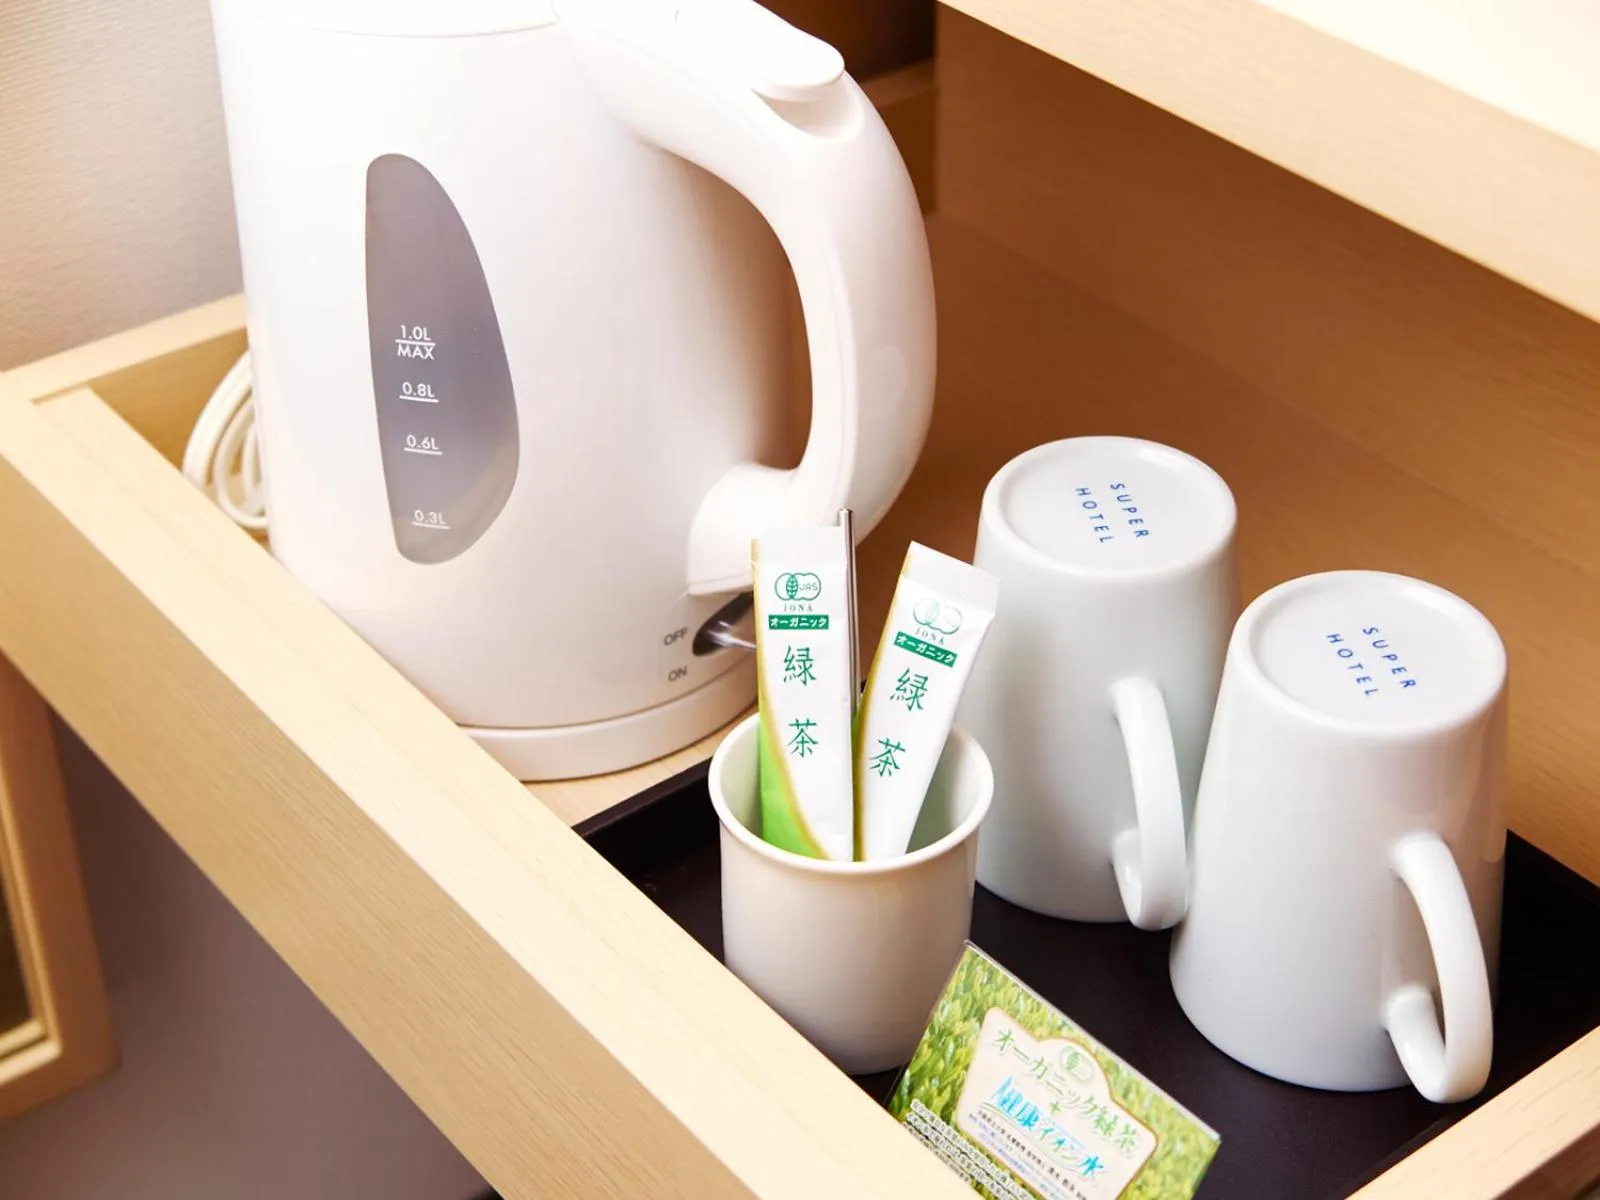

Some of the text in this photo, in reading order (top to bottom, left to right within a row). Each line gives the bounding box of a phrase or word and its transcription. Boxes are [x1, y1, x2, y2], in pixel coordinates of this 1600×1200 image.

[401, 324, 431, 341] 1.0L
[397, 344, 434, 360] MAX
[402, 382, 435, 398] 0.8L
[406, 434, 439, 450] 0.6L
[414, 509, 446, 525] 0.3L
[1075, 487, 1114, 543] HOTEL
[1110, 483, 1149, 538] SUPER
[783, 604, 813, 613] JONA
[769, 616, 827, 628] オーガニック
[663, 626, 688, 646] OFF
[896, 634, 955, 664] オーガニック
[1362, 627, 1416, 688] SUPER
[668, 665, 687, 682] ON
[1326, 633, 1379, 697] HOTEL
[783, 645, 819, 758] 緑茶
[869, 667, 929, 777] 緑茶
